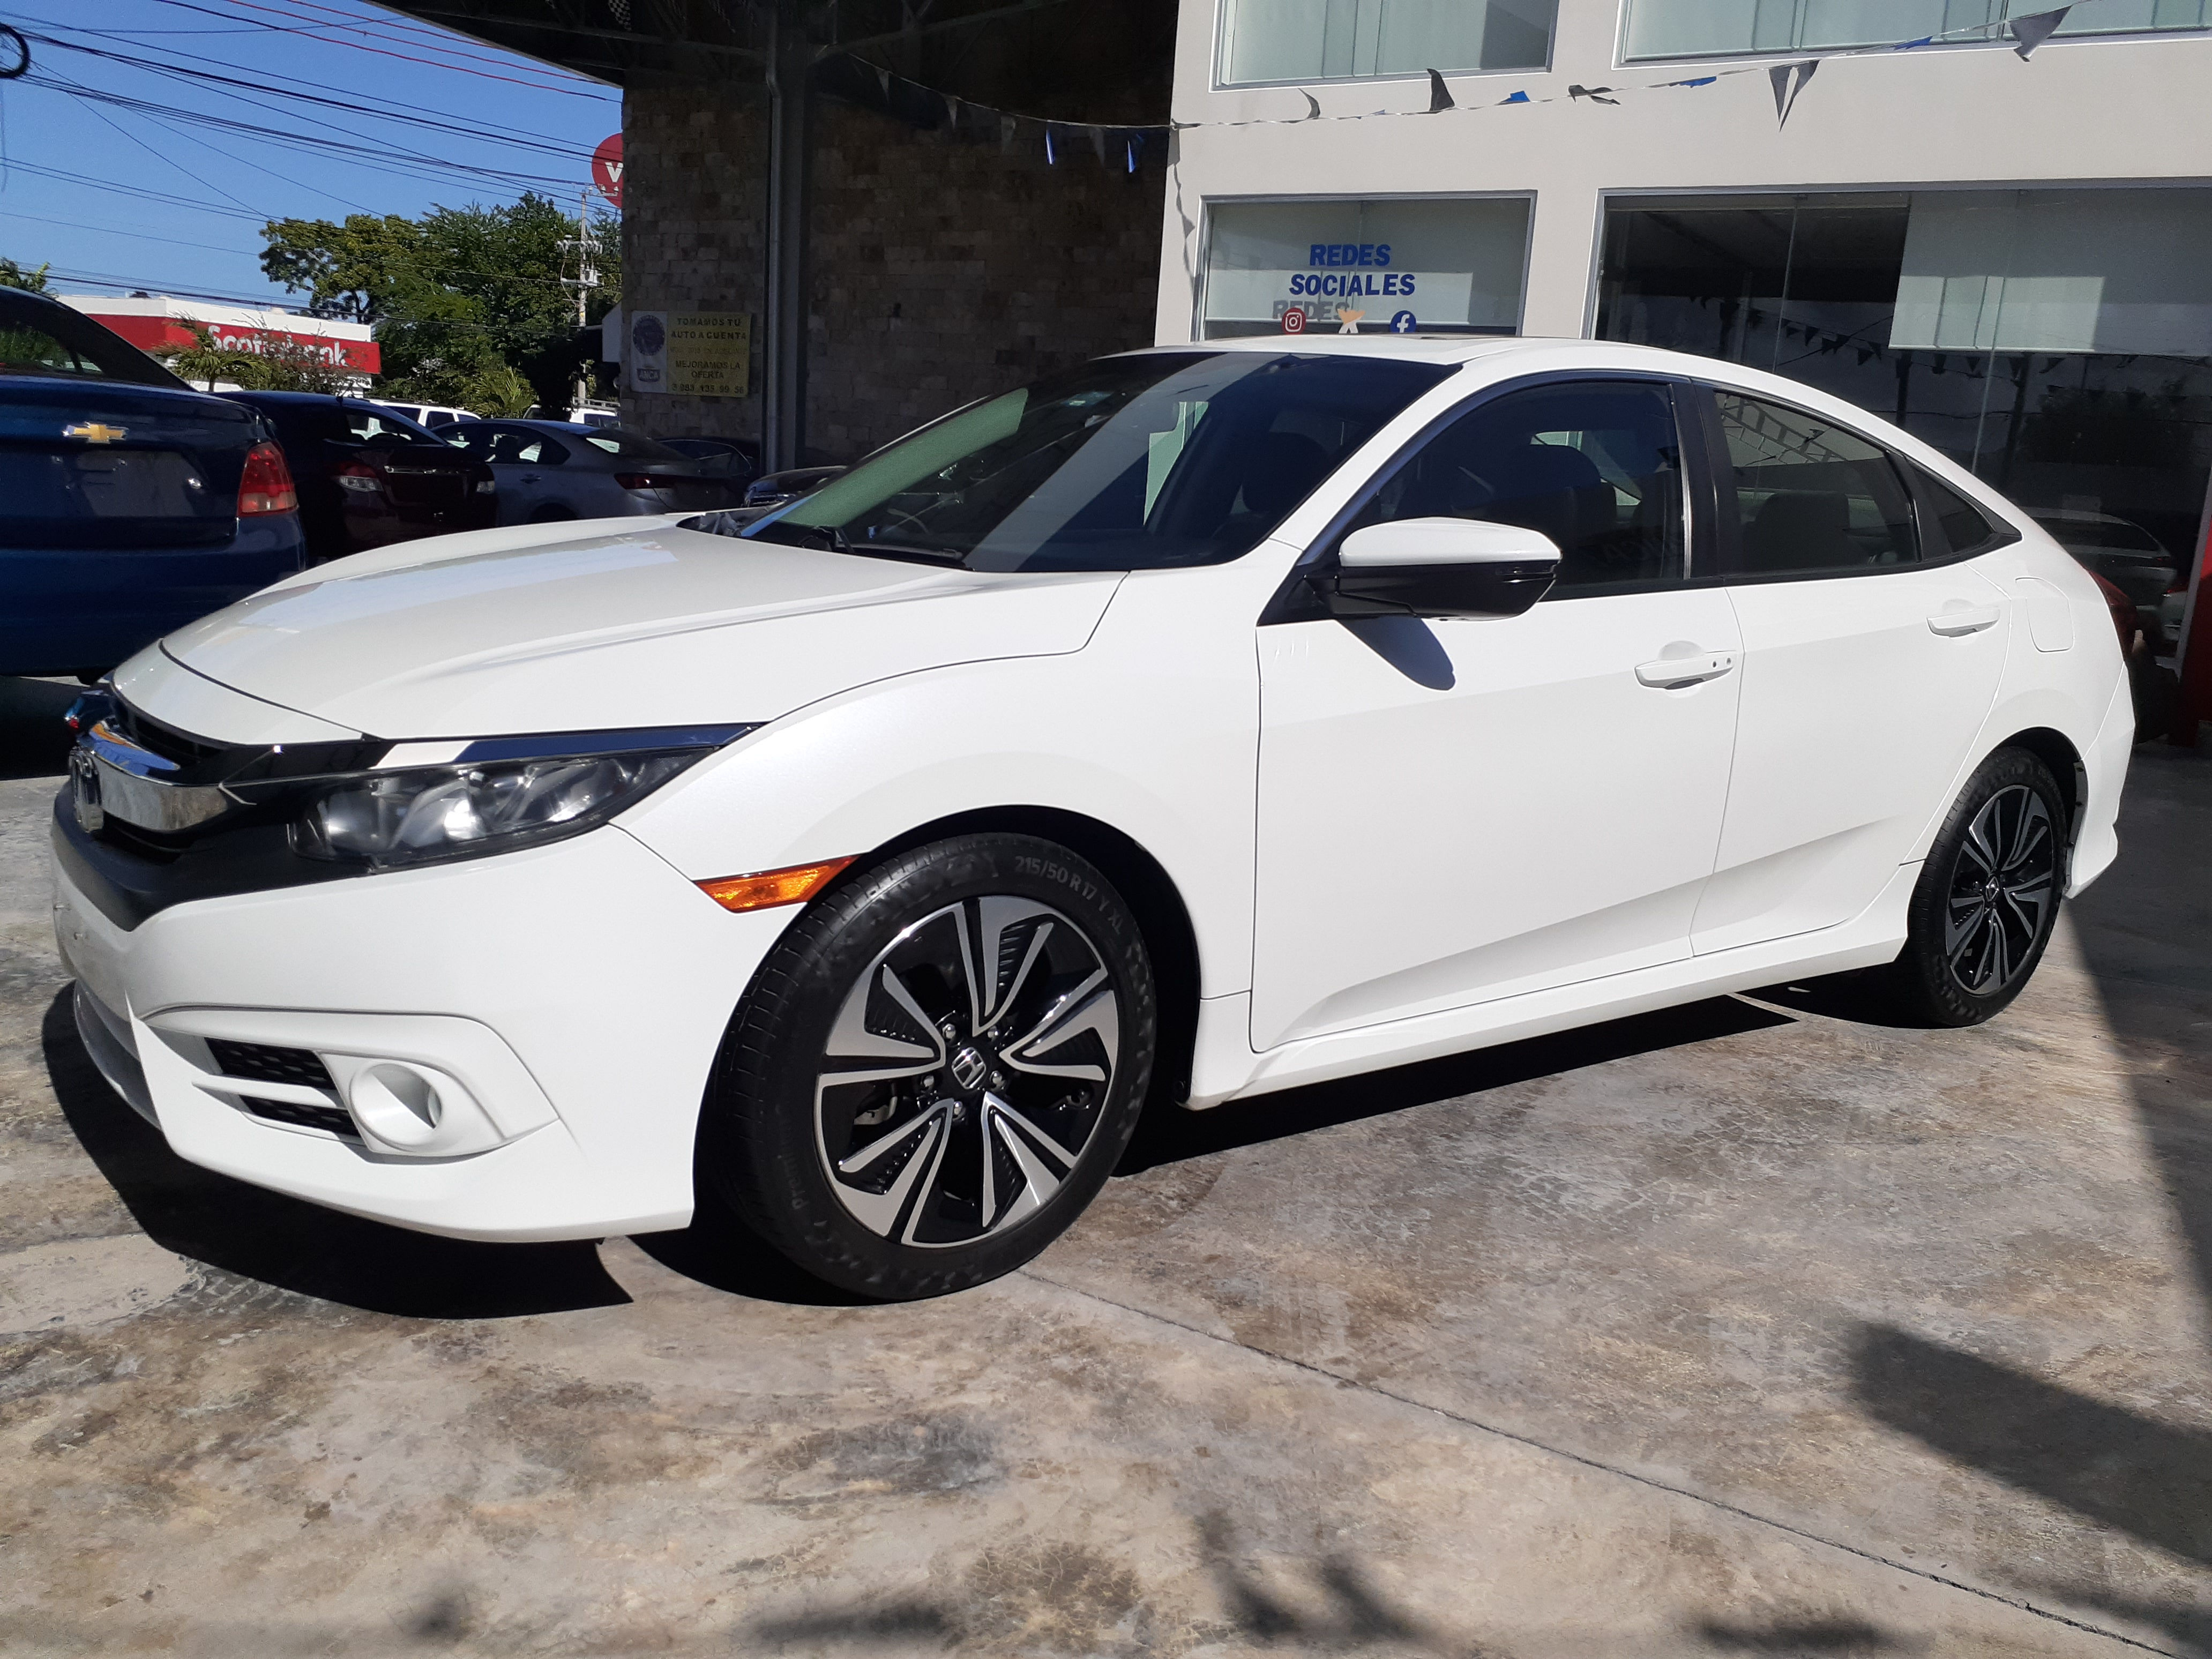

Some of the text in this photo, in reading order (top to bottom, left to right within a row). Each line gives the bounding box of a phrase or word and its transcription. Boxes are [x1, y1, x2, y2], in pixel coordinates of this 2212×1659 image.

[1310, 243, 1391, 266] REDES
[1289, 273, 1416, 297] SOCIALES
[677, 318, 724, 326] TOMAMOS
[671, 331, 696, 339] AUTO
[706, 332, 746, 340] CUENTA
[208, 325, 348, 367] Scotibank
[675, 360, 740, 369] MEJORAMOS LA
[691, 370, 724, 379] OFERTA
[1015, 856, 1124, 935] 215/50 R 17 Y XL
